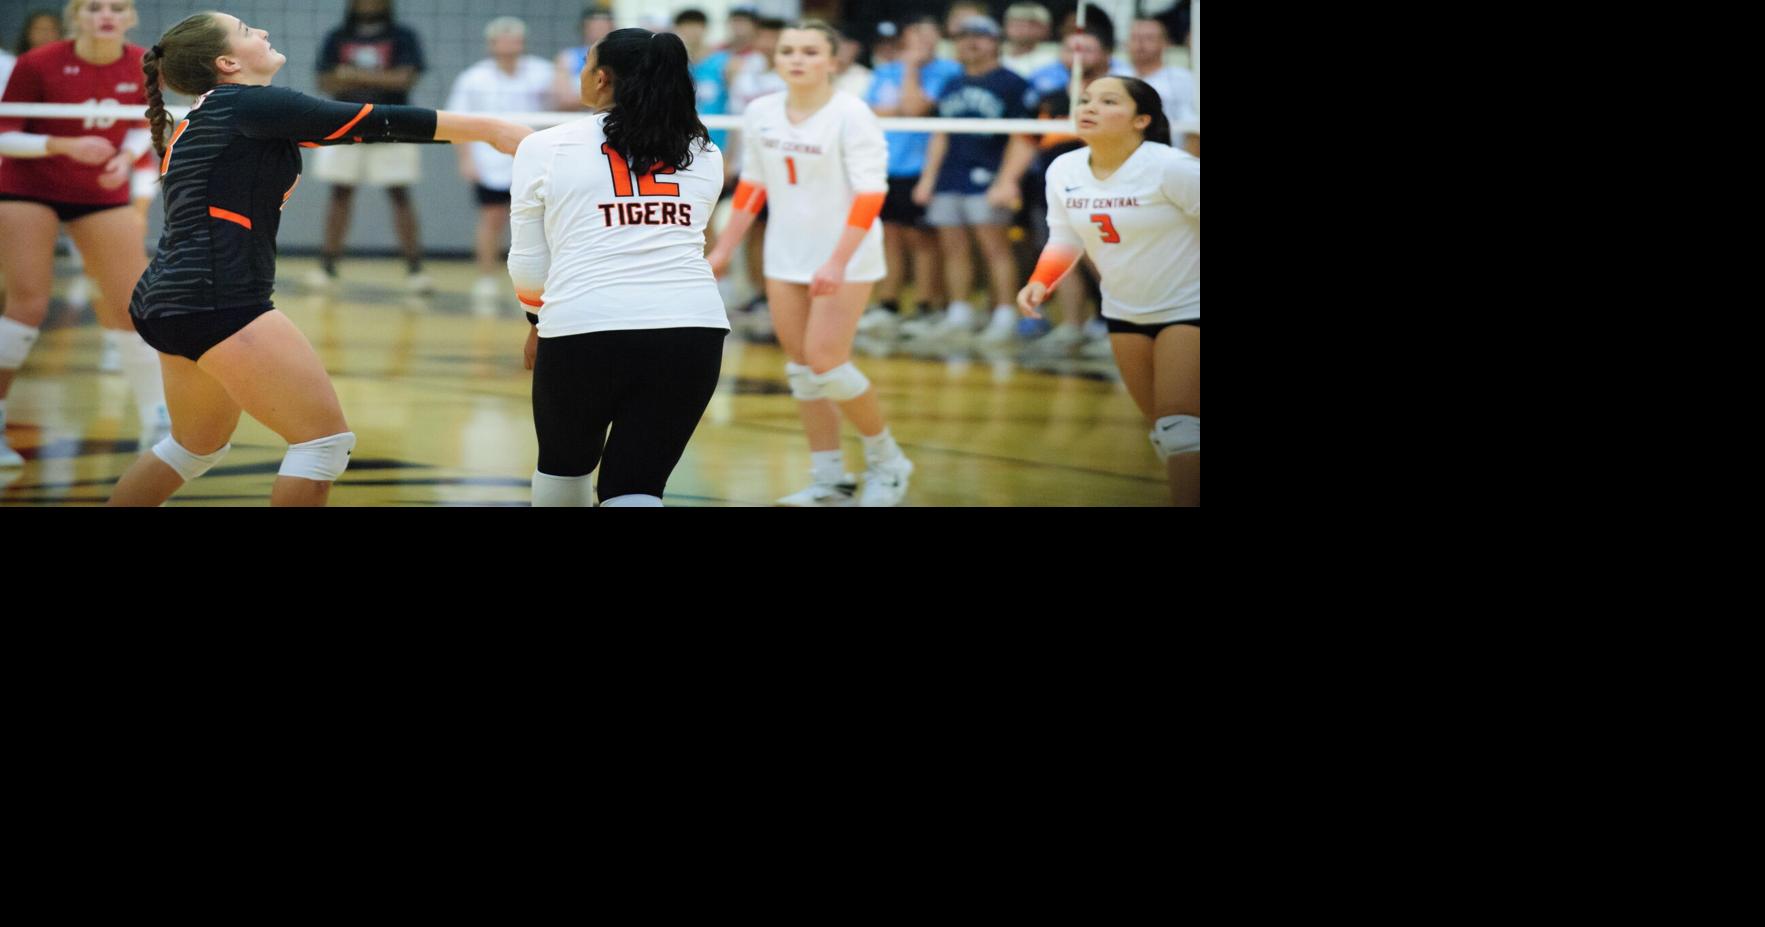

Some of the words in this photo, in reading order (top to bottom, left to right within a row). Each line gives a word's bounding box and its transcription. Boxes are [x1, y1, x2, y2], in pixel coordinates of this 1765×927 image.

[784, 155, 798, 186] 1
[598, 202, 692, 227] TIGERS
[1065, 197, 1089, 209] EAST
[1092, 196, 1140, 209] CENTRAL
[1089, 212, 1121, 244] 3
